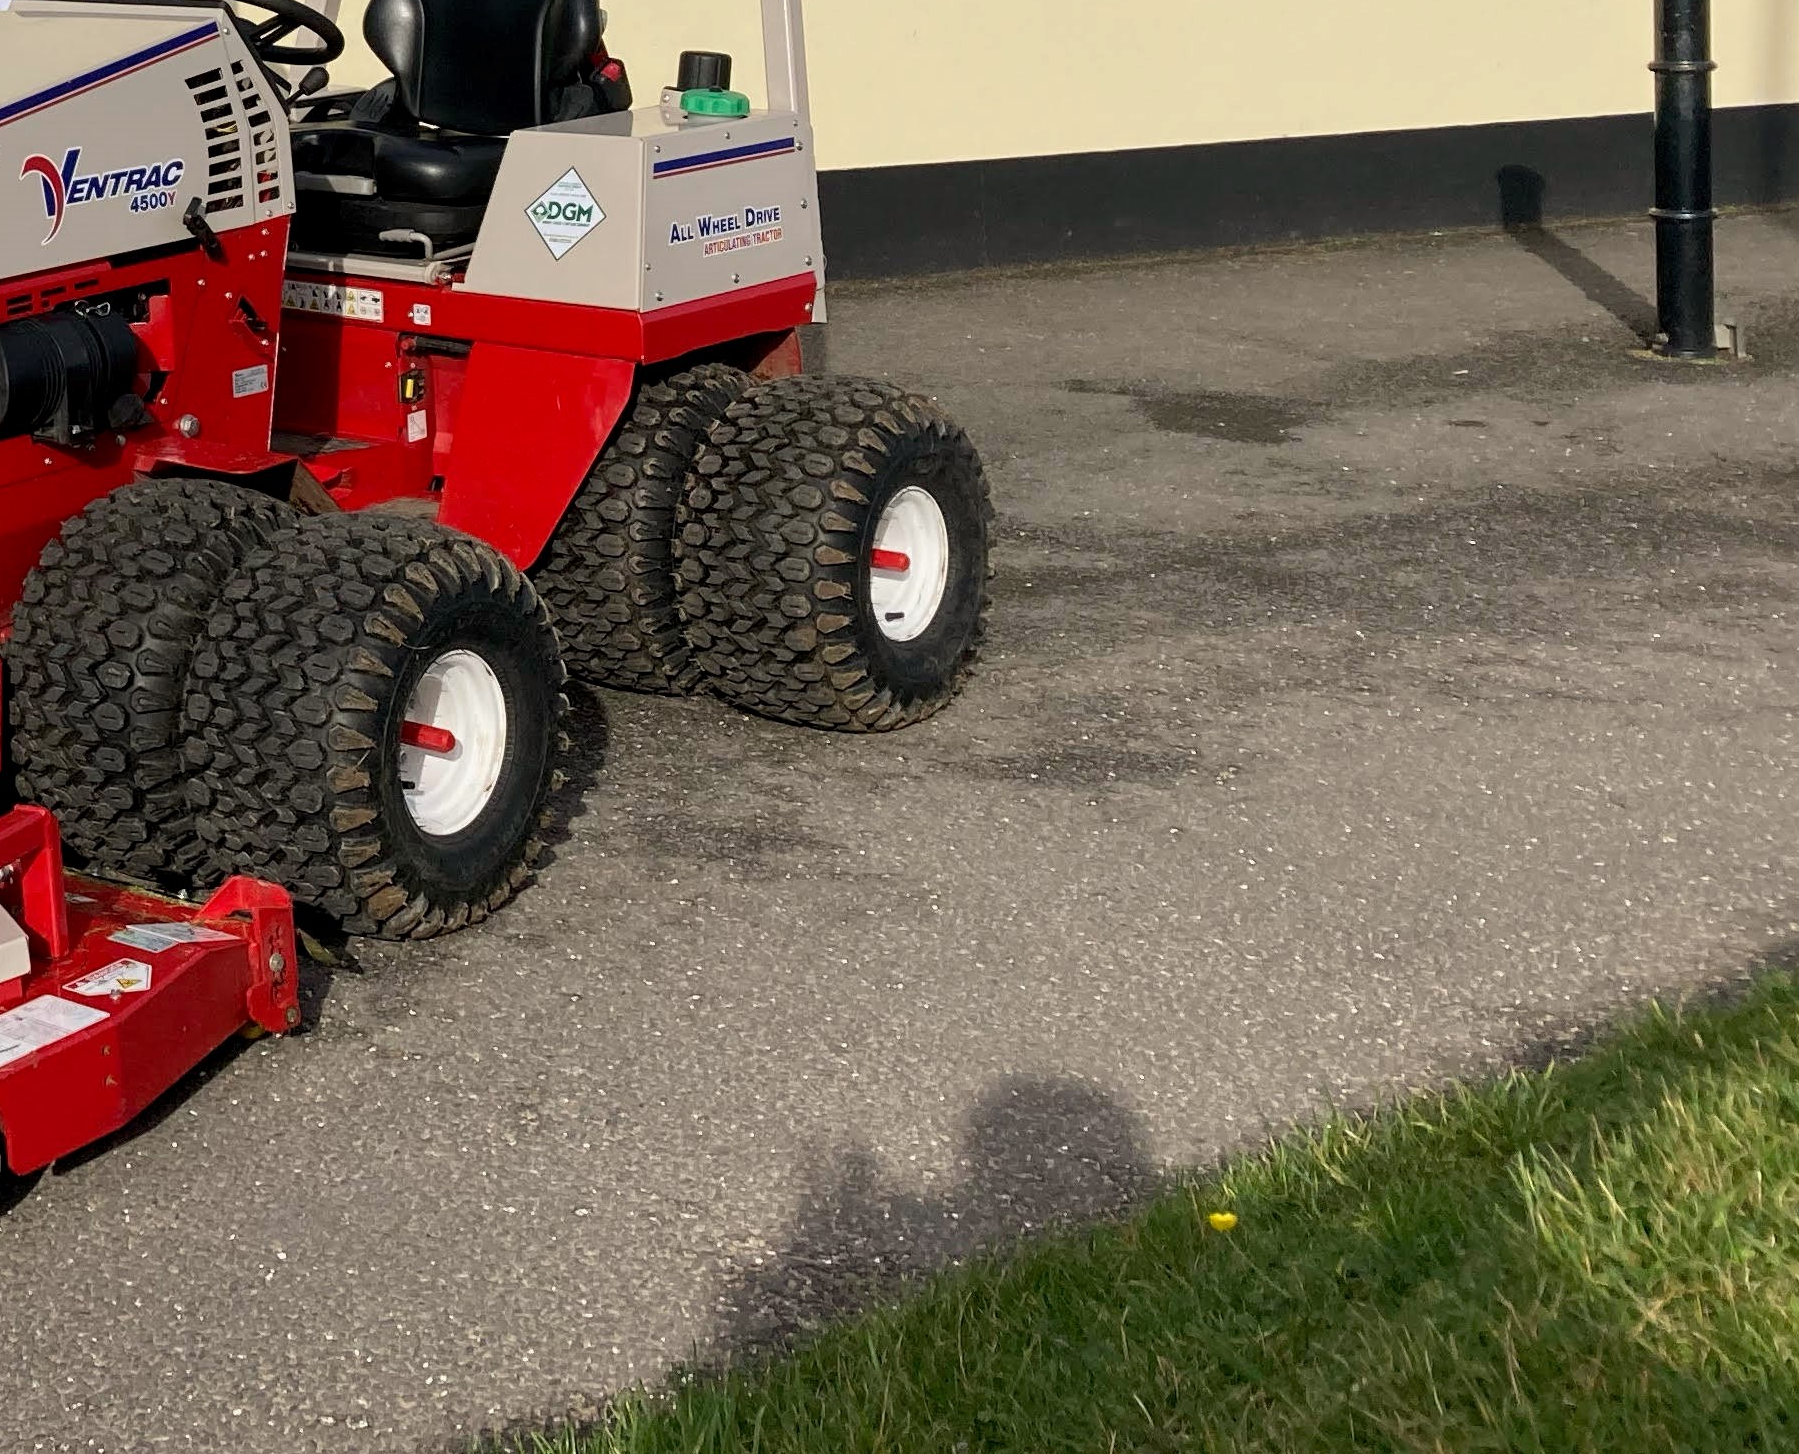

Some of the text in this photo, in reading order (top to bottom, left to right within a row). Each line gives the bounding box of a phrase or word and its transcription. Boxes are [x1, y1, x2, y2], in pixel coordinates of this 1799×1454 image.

[21, 148, 184, 245] VENTRAC
[130, 191, 176, 213] 4500Y
[547, 201, 594, 223] DGM
[704, 228, 783, 256] ARTICULATING TRACTOR
